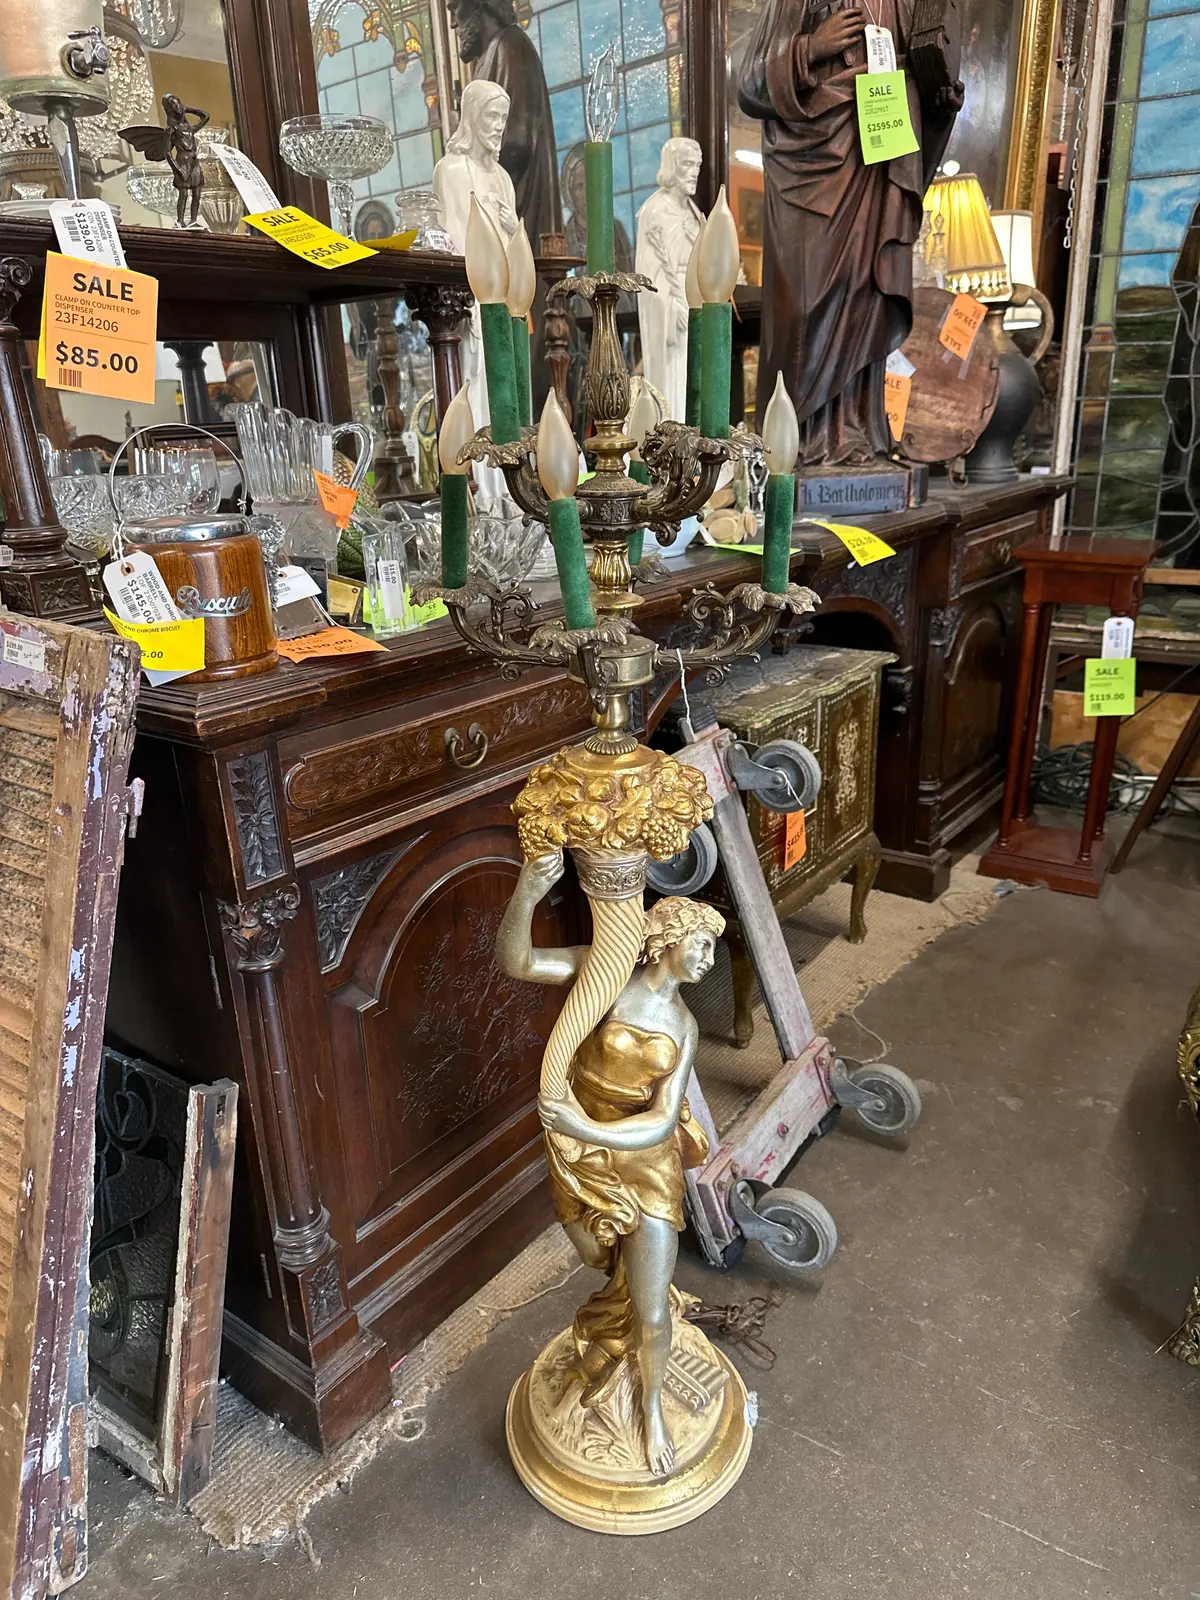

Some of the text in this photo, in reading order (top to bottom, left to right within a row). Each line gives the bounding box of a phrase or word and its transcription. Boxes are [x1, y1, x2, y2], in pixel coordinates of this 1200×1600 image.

[869, 85, 892, 97] SALE
[867, 119, 903, 133] $2595.00
[94, 212, 107, 240] DISPENSER
[262, 213, 300, 226] SALE
[75, 212, 95, 252] $139.00
[91, 226, 104, 252] 23F14206
[100, 211, 121, 266] CLAMP ON COUNTER
[302, 242, 349, 261] $65.00
[73, 273, 134, 302] SALE
[55, 294, 140, 316] CLAMP ON COUNTER TOP
[55, 302, 93, 314] DISPENSER
[56, 311, 119, 332] 23F14206
[944, 334, 961, 351] SALE
[56, 341, 138, 374] $85.00
[886, 377, 902, 389] ALE
[142, 573, 158, 600] BARRELL
[148, 570, 178, 621] WOOD AND CHRO
[128, 580, 155, 624] $145.00
[177, 586, 252, 617] Biscuit
[141, 650, 163, 658] 5.00
[1096, 667, 1120, 676] SALE
[1089, 693, 1125, 702] $119.00
